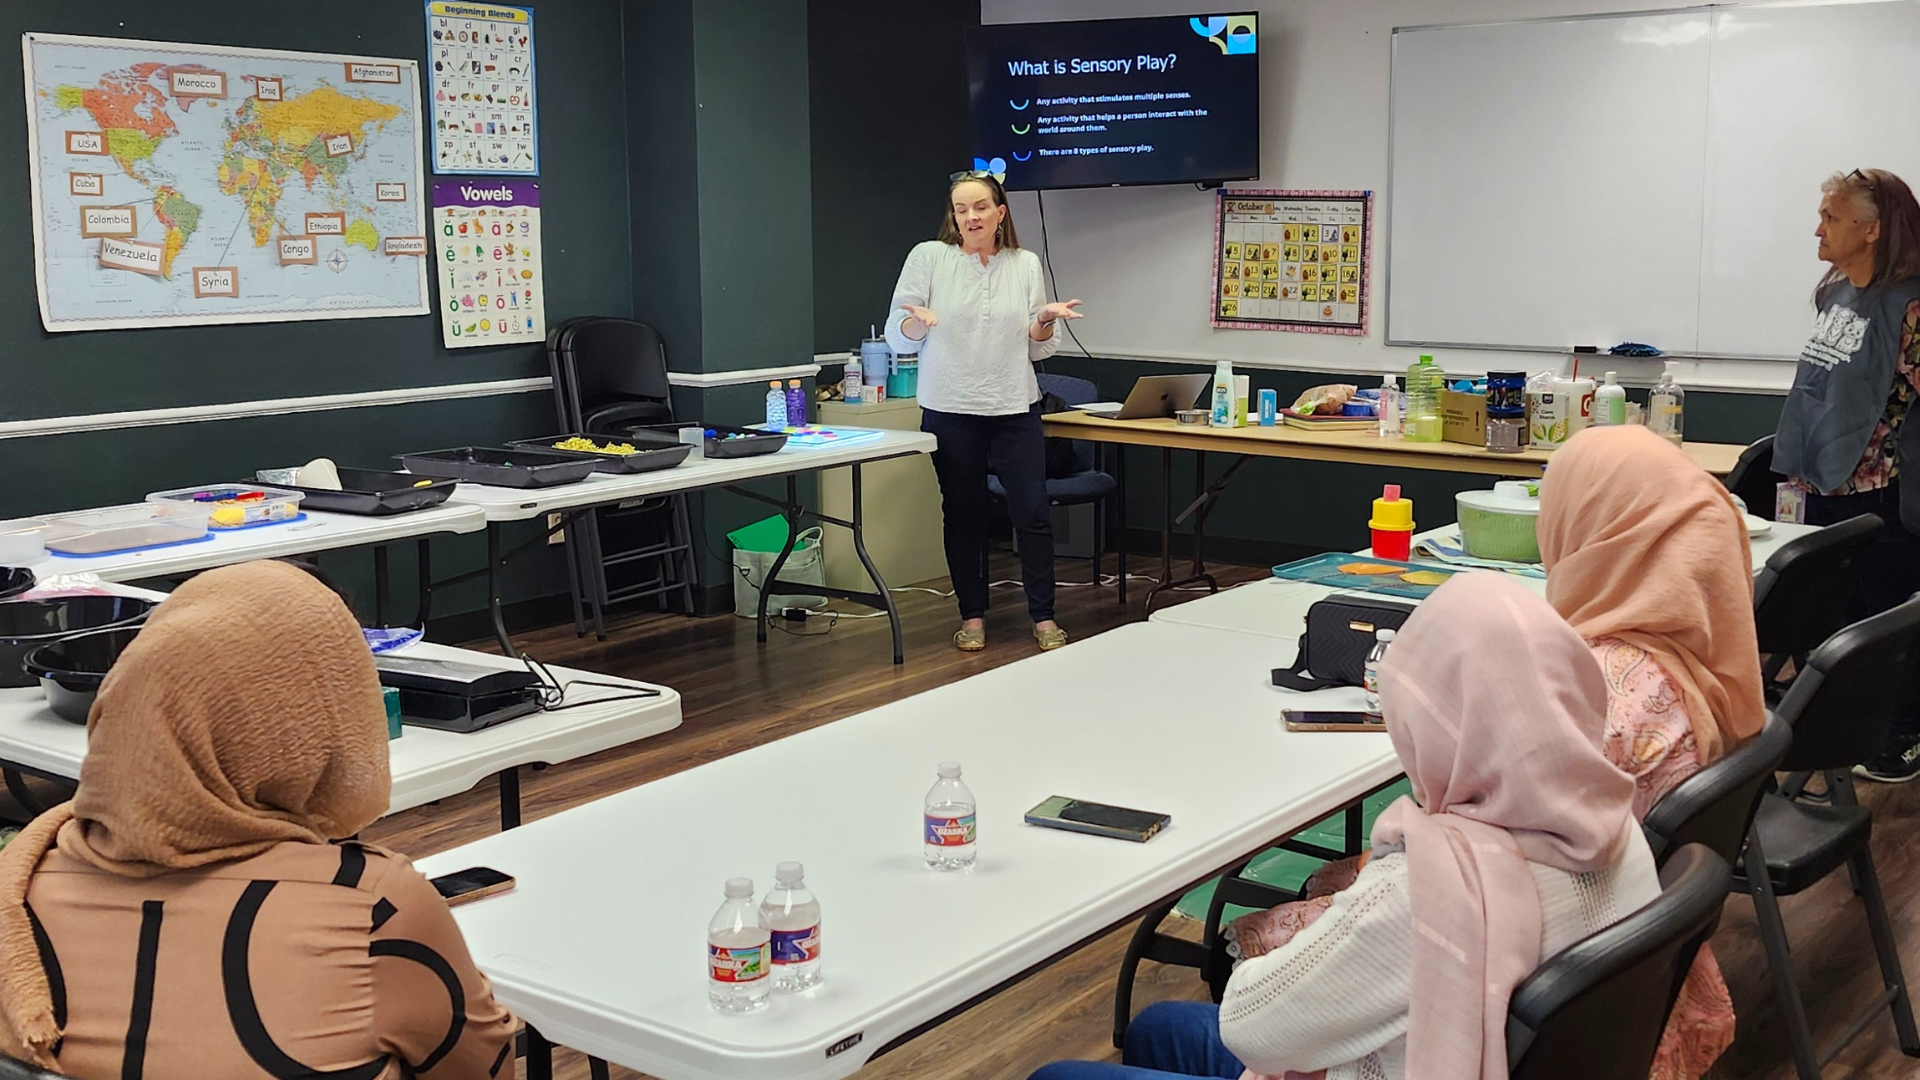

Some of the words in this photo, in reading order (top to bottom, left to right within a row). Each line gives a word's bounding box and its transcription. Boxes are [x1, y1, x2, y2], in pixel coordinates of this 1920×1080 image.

[444, 6, 486, 17] Beginning
[488, 10, 515, 18] Blends
[440, 19, 448, 27] bl
[513, 26, 520, 35] gl
[441, 49, 448, 58] pl
[466, 51, 472, 59] sl
[1008, 60, 1050, 76] What
[1054, 59, 1066, 74] is
[1070, 58, 1132, 74] Sensory
[1136, 54, 1177, 72] Play?
[354, 67, 394, 77] Afghanistan
[177, 77, 217, 89] Morocco
[442, 80, 450, 88] dr
[492, 84, 500, 92] gr
[260, 86, 276, 97] Iraq
[516, 85, 523, 93] pr
[1036, 98, 1050, 106] Any
[1052, 96, 1078, 105] activity
[1096, 94, 1134, 102] stimulates
[1134, 92, 1164, 102] multiple
[444, 110, 450, 118] tr
[468, 111, 476, 119] sk
[1037, 116, 1051, 124] Any
[1052, 114, 1080, 124] activity
[1080, 114, 1096, 122] that
[1096, 113, 1116, 122] helps
[1122, 112, 1147, 121] person
[1194, 108, 1208, 116] the
[1038, 126, 1058, 134] world
[1086, 124, 1108, 132] them.
[77, 140, 98, 150] USA
[332, 141, 348, 152] Iran
[444, 141, 454, 149] sp
[1038, 148, 1060, 156] There
[1060, 148, 1072, 156] are
[1079, 148, 1099, 156] types
[1100, 146, 1108, 154] of
[1108, 146, 1136, 154] sensory
[1136, 144, 1154, 153] play.
[75, 178, 96, 188] Cuba
[380, 190, 400, 198] Korea
[460, 185, 514, 201] Vowels
[1238, 202, 1264, 210] October
[88, 214, 130, 225] Colombia
[309, 222, 338, 232] Ethiopia
[1292, 229, 1296, 237] 1
[1351, 230, 1356, 238] 4
[282, 244, 310, 256] Congo
[387, 242, 423, 252] Bangladesh
[1234, 246, 1238, 254] 5
[1248, 247, 1252, 255] 6
[1292, 249, 1297, 257] 8
[1304, 249, 1309, 257] 9
[1329, 249, 1337, 257] 10
[1349, 250, 1355, 258] 11
[104, 243, 158, 262] Venezuela
[1250, 266, 1258, 274] 13
[1269, 267, 1277, 275] 14
[1308, 269, 1317, 277] 16
[1328, 269, 1335, 277] 17
[1343, 270, 1350, 278] 18
[201, 276, 229, 290] Syria
[1230, 284, 1238, 292] 19
[1250, 285, 1259, 293] 20
[1289, 286, 1297, 294] 22
[1307, 287, 1316, 295] 23
[1346, 289, 1356, 297] 25
[1228, 303, 1237, 311] 26
